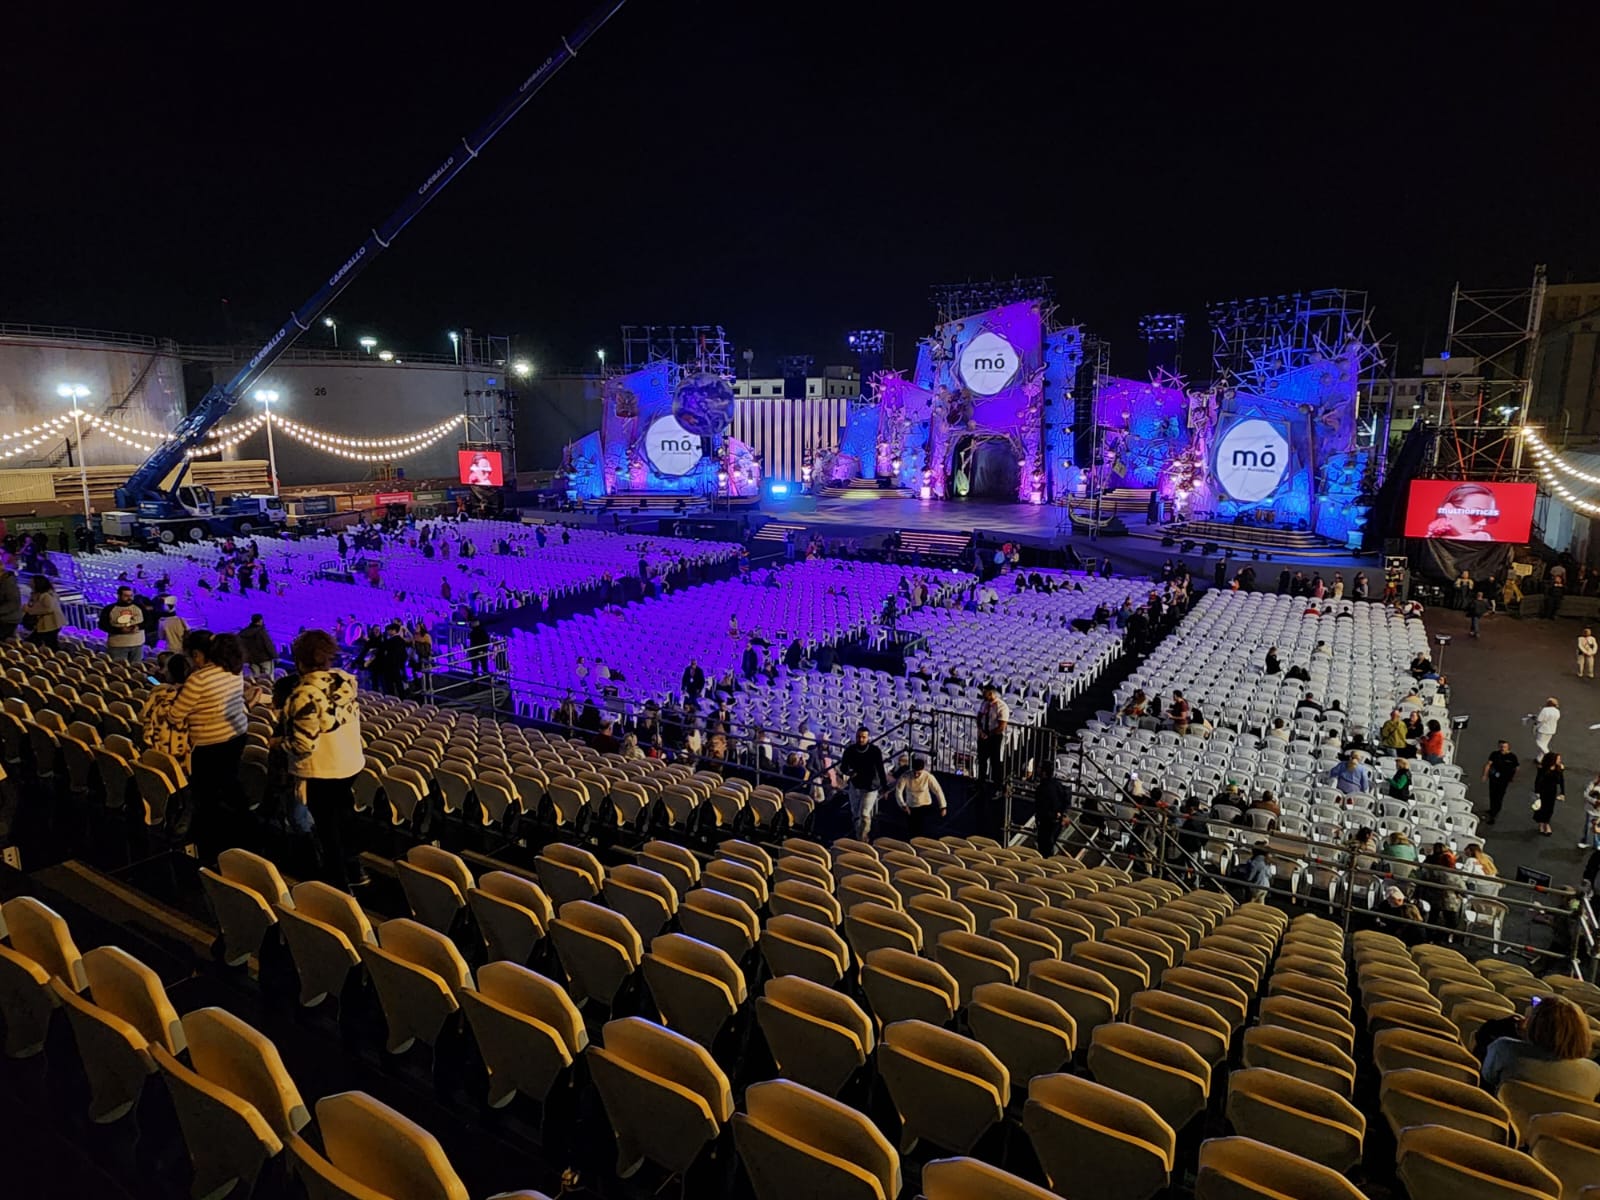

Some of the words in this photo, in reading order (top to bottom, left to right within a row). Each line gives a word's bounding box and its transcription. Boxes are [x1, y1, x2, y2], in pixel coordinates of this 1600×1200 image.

[419, 156, 454, 194] CARBALLO
[329, 246, 365, 286] CARBALLO
[250, 328, 285, 368] CARBALLO
[314, 387, 327, 396] 26
